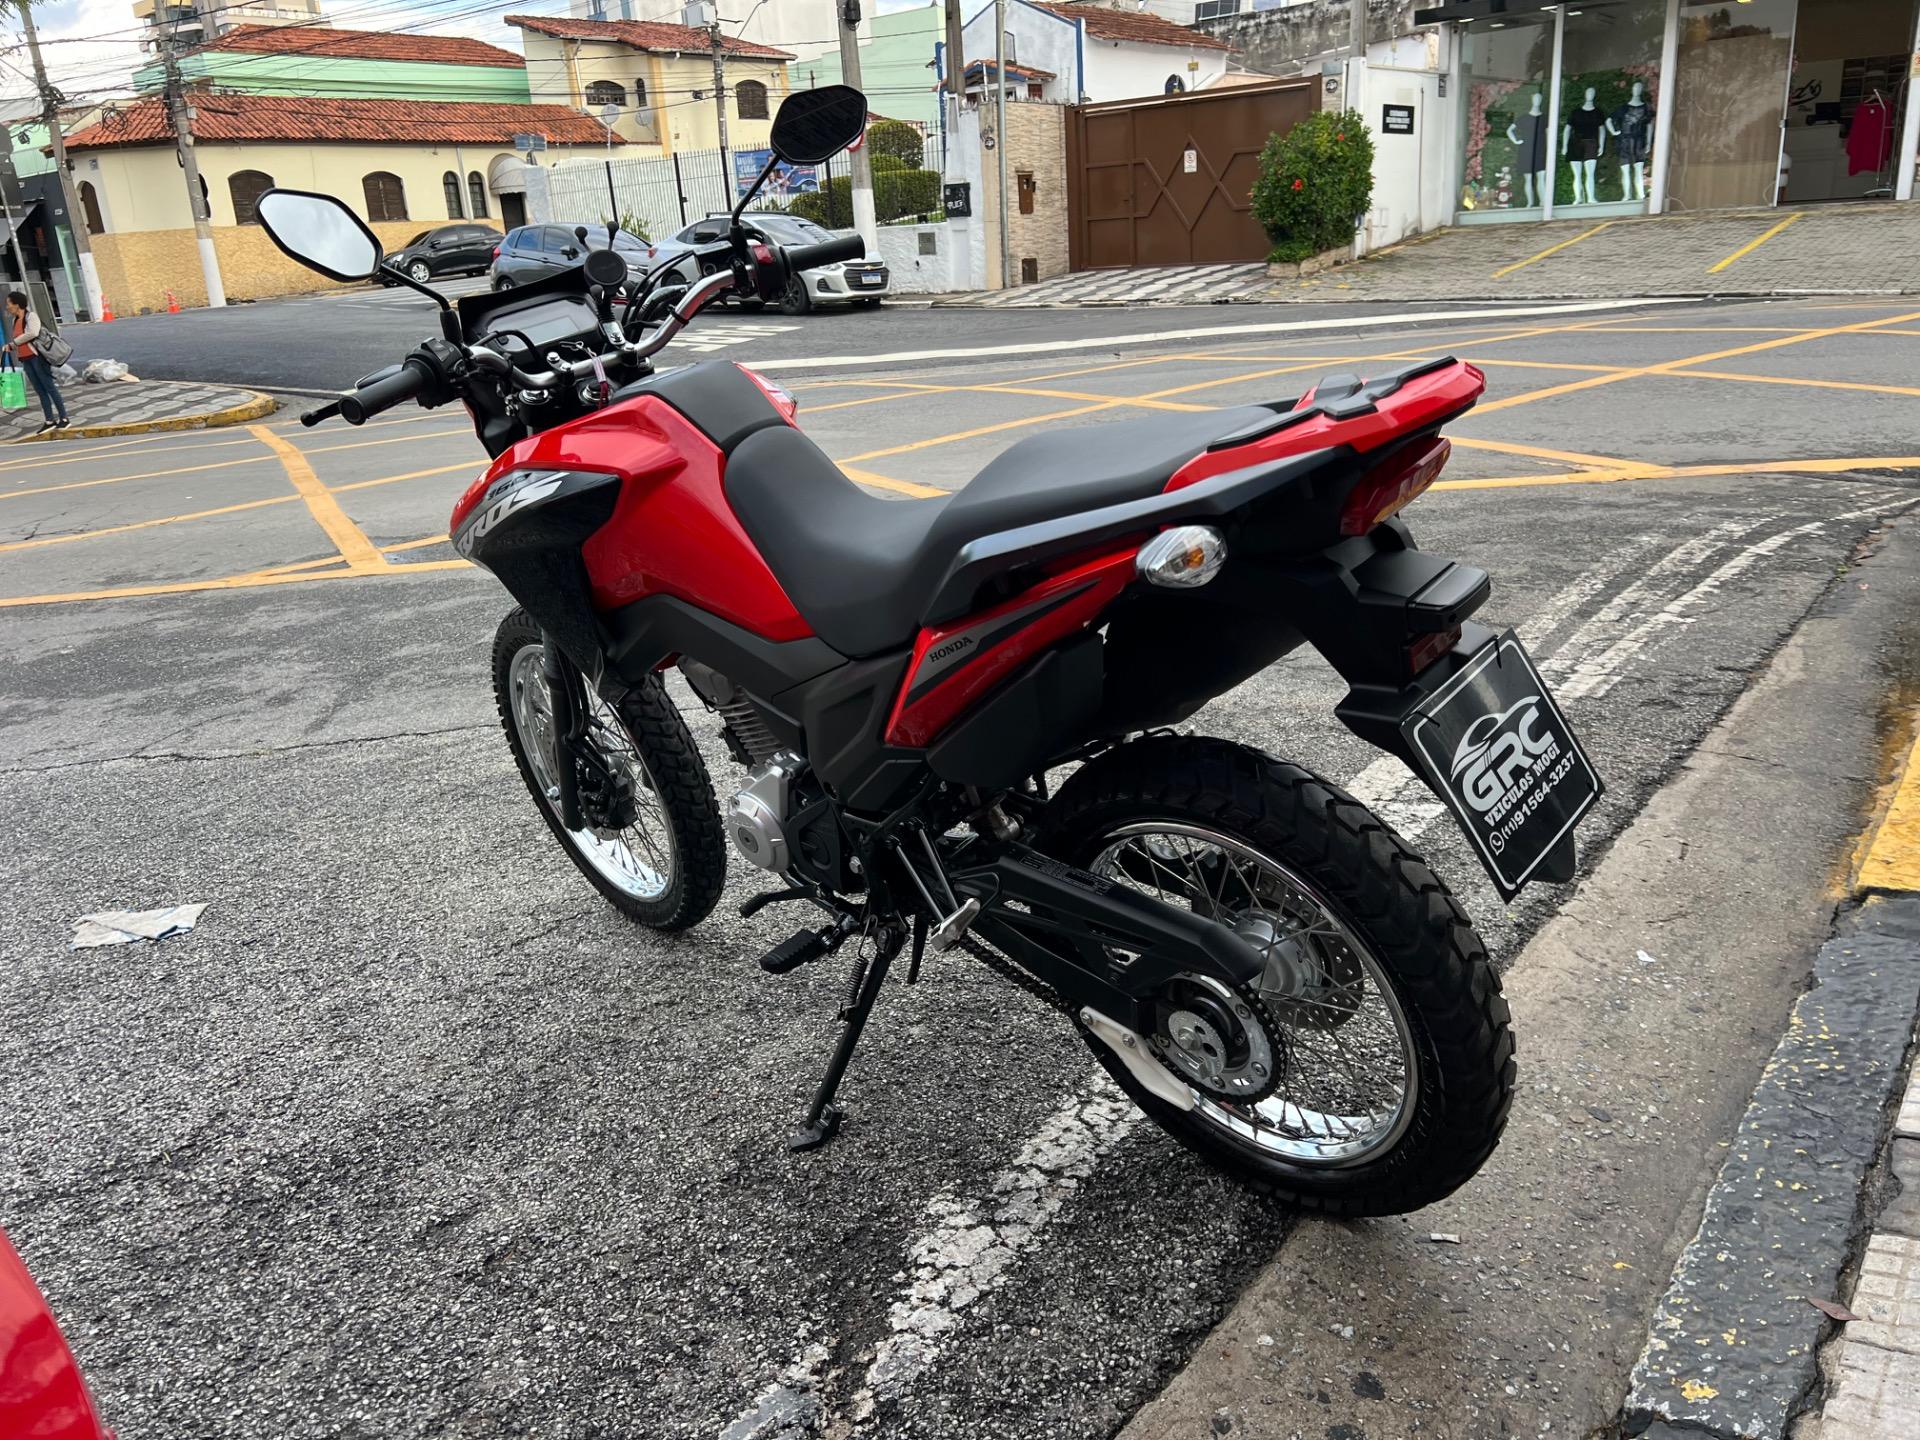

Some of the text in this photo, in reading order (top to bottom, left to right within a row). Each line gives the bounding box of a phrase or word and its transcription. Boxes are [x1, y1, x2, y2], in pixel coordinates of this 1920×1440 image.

[929, 636, 974, 663] HONDA
[1462, 706, 1555, 812] GRC
[1484, 743, 1561, 827] VEICULOS MOGI
[1502, 750, 1577, 840] (11)91564-3237
